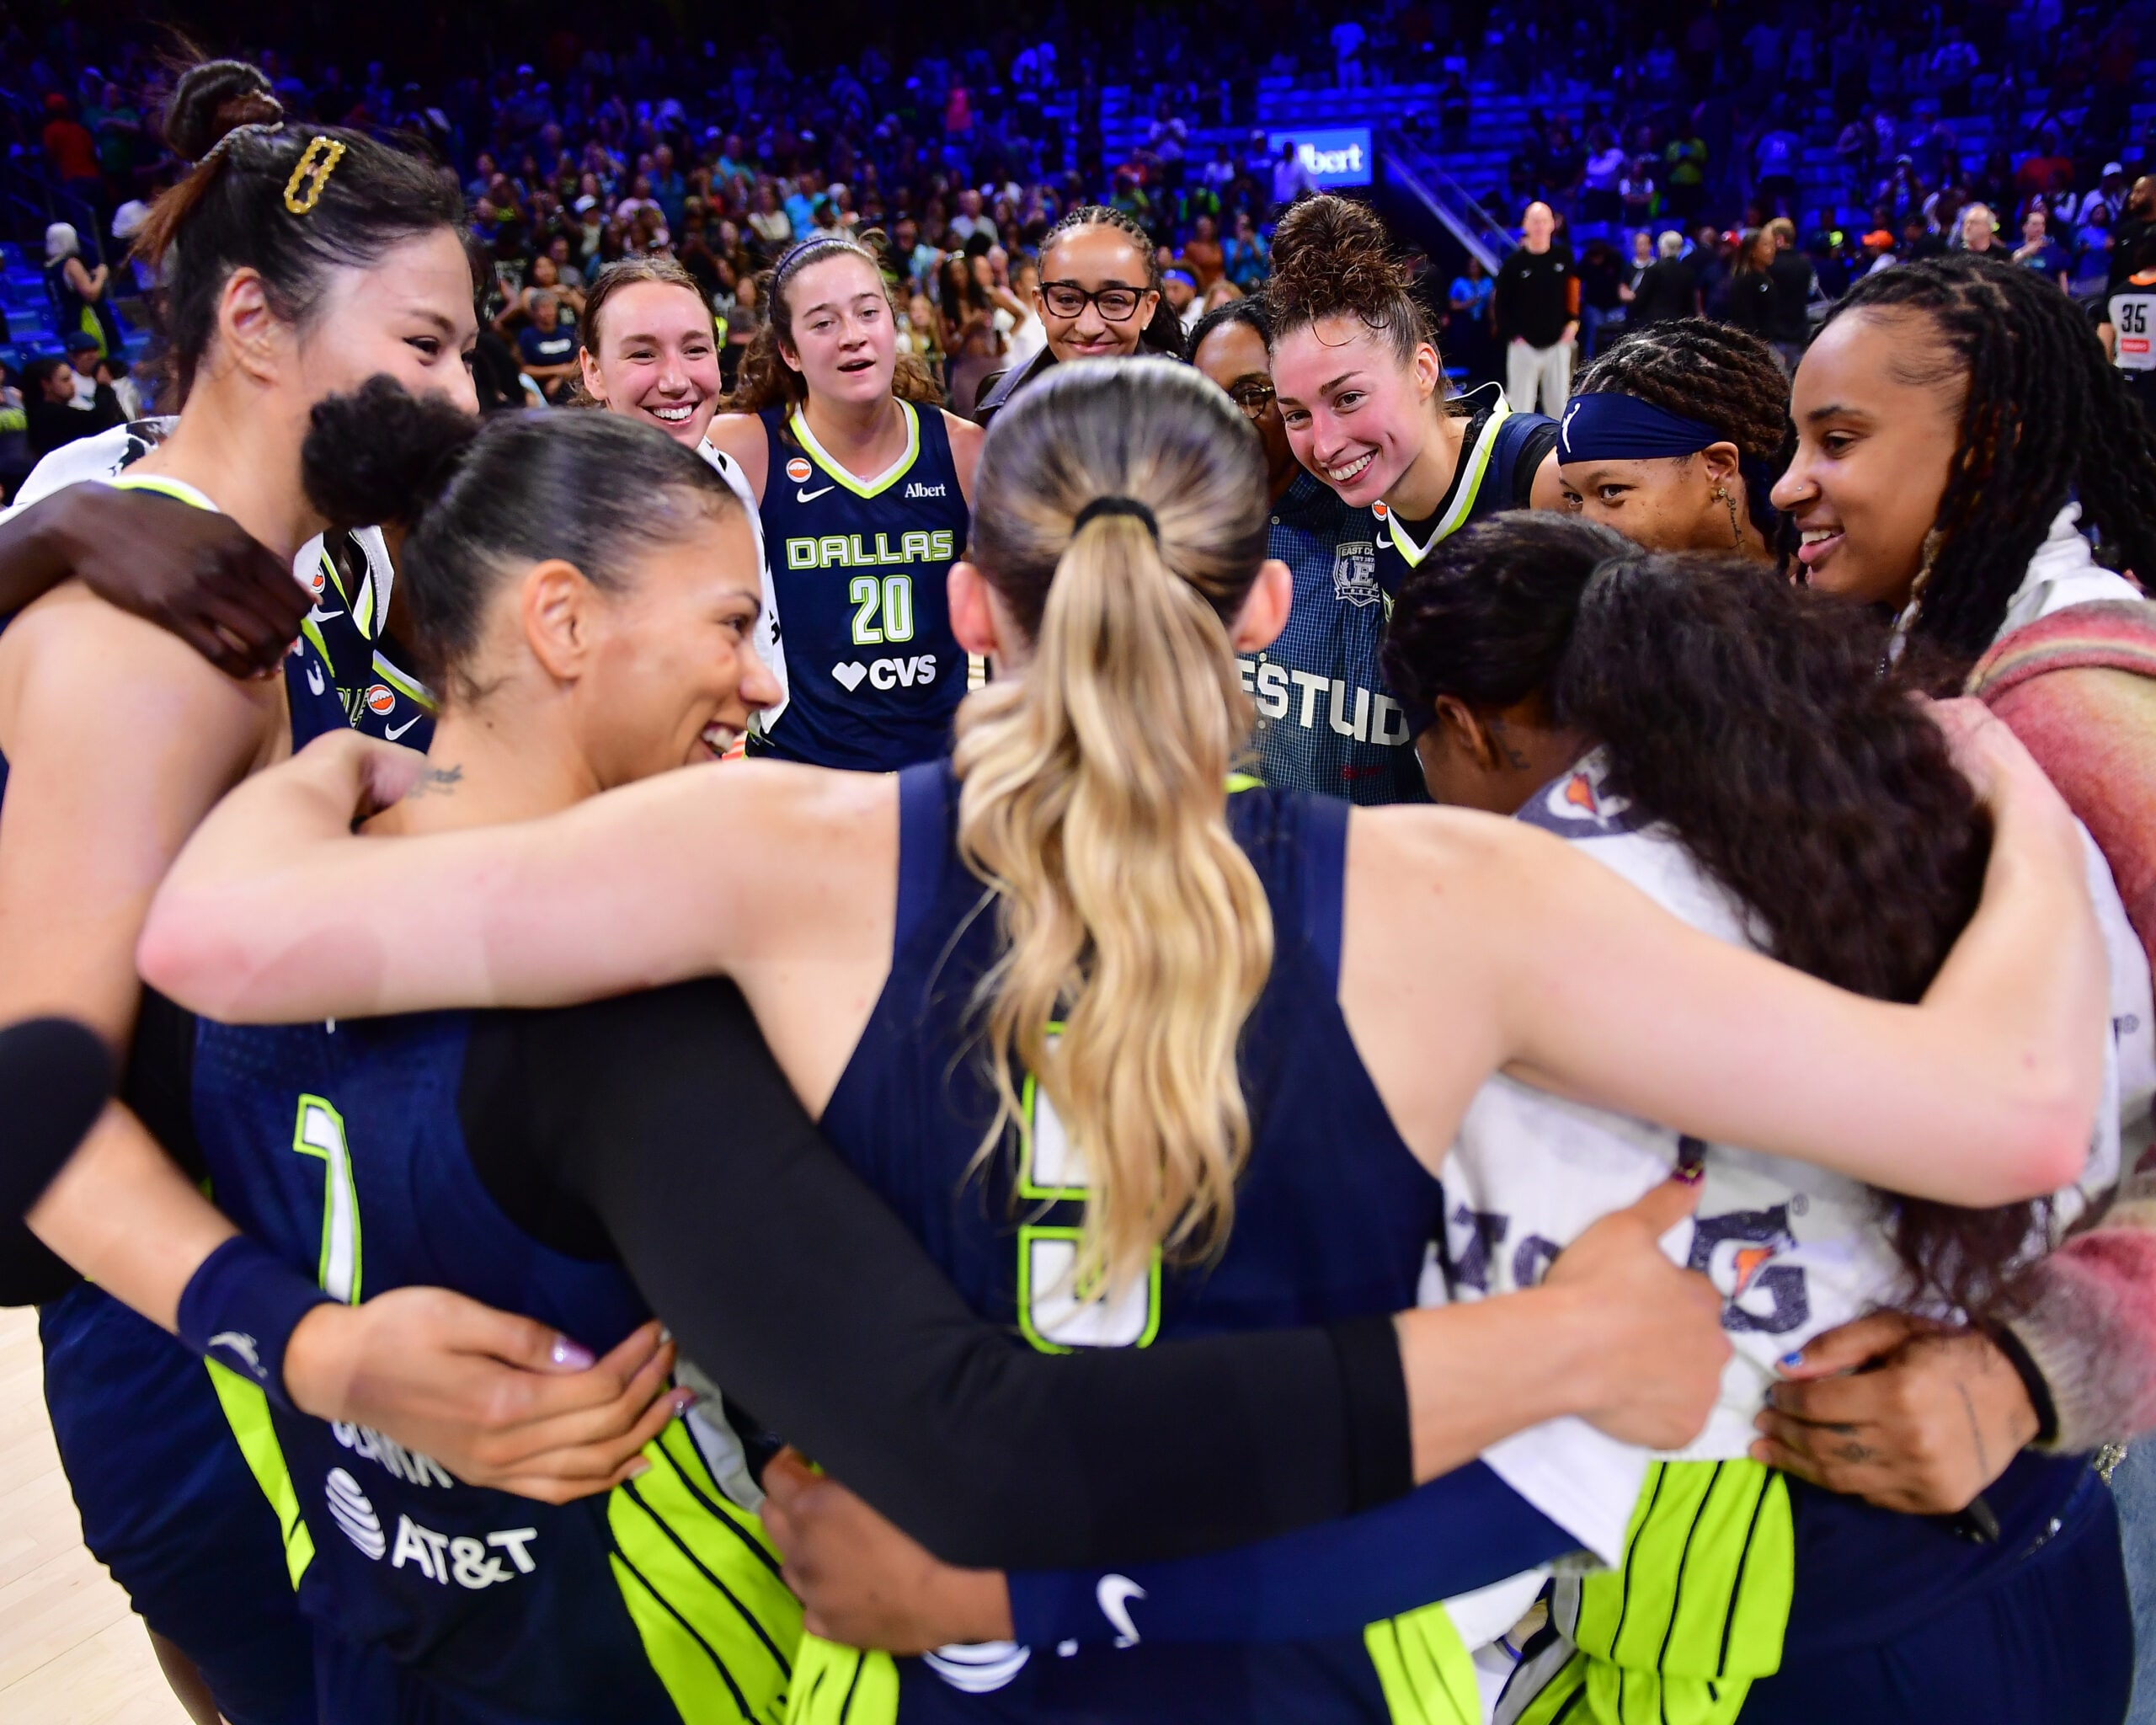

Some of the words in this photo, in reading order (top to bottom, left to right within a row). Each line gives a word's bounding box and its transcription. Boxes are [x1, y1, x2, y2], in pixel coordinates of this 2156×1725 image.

[1298, 143, 1364, 174] lbert
[2121, 303, 2148, 334] 35
[904, 482, 947, 499] Albert
[785, 530, 953, 570] DALLAS
[1342, 547, 1363, 557] EAST
[849, 574, 914, 645] 20
[869, 654, 937, 691] CVS
[392, 1513, 538, 1589] AT&T
